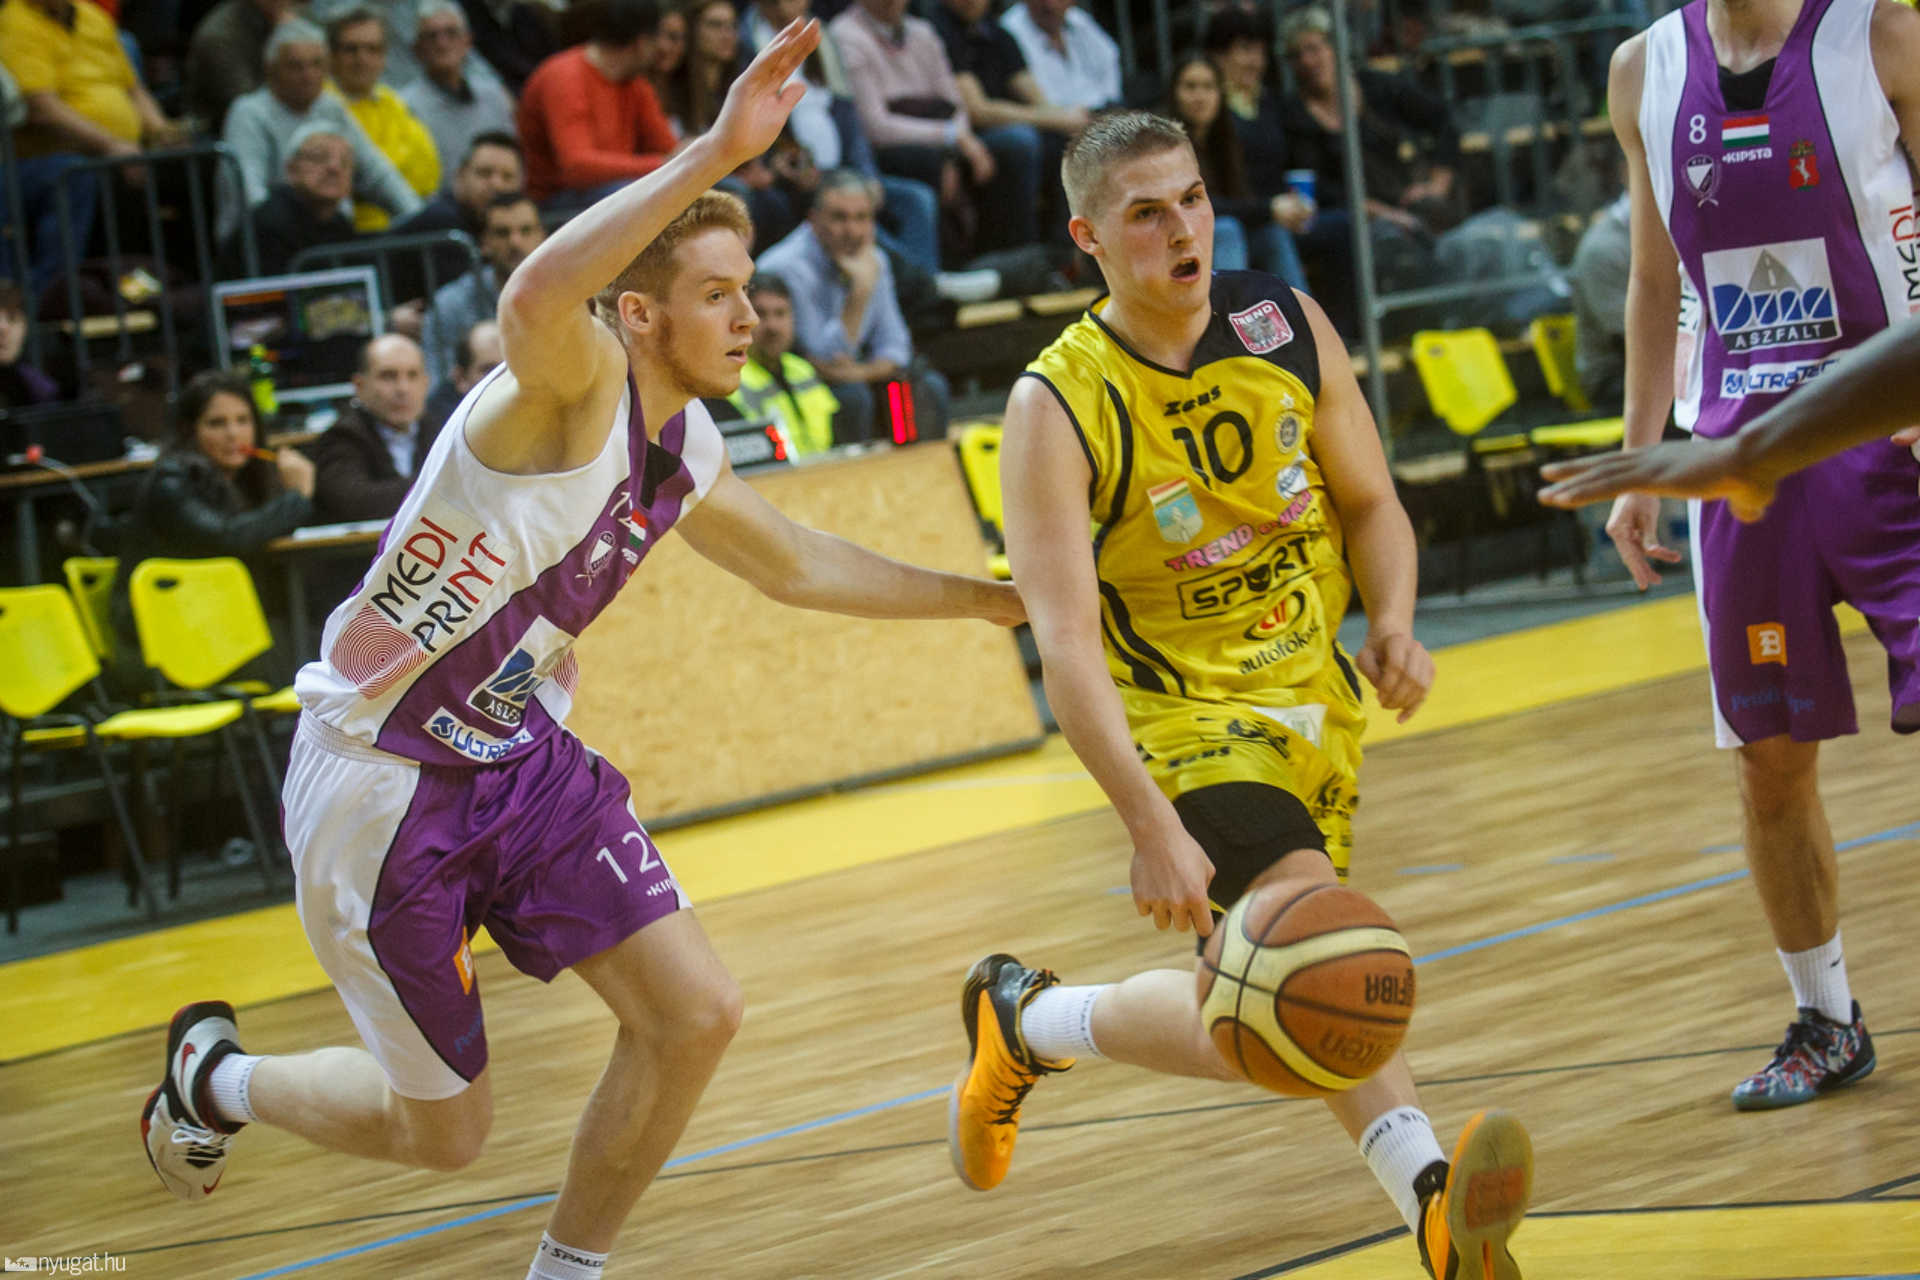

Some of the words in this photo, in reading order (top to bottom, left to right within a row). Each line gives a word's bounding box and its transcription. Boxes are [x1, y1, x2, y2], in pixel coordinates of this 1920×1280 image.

[1689, 114, 1706, 144] 8
[1231, 303, 1273, 326] TREND
[1734, 325, 1823, 348] ASZFALT
[1171, 410, 1254, 491] 10
[370, 516, 457, 624] MEDI
[1164, 523, 1255, 571] TREND
[411, 532, 506, 653] PRINT
[596, 830, 661, 884] 12
